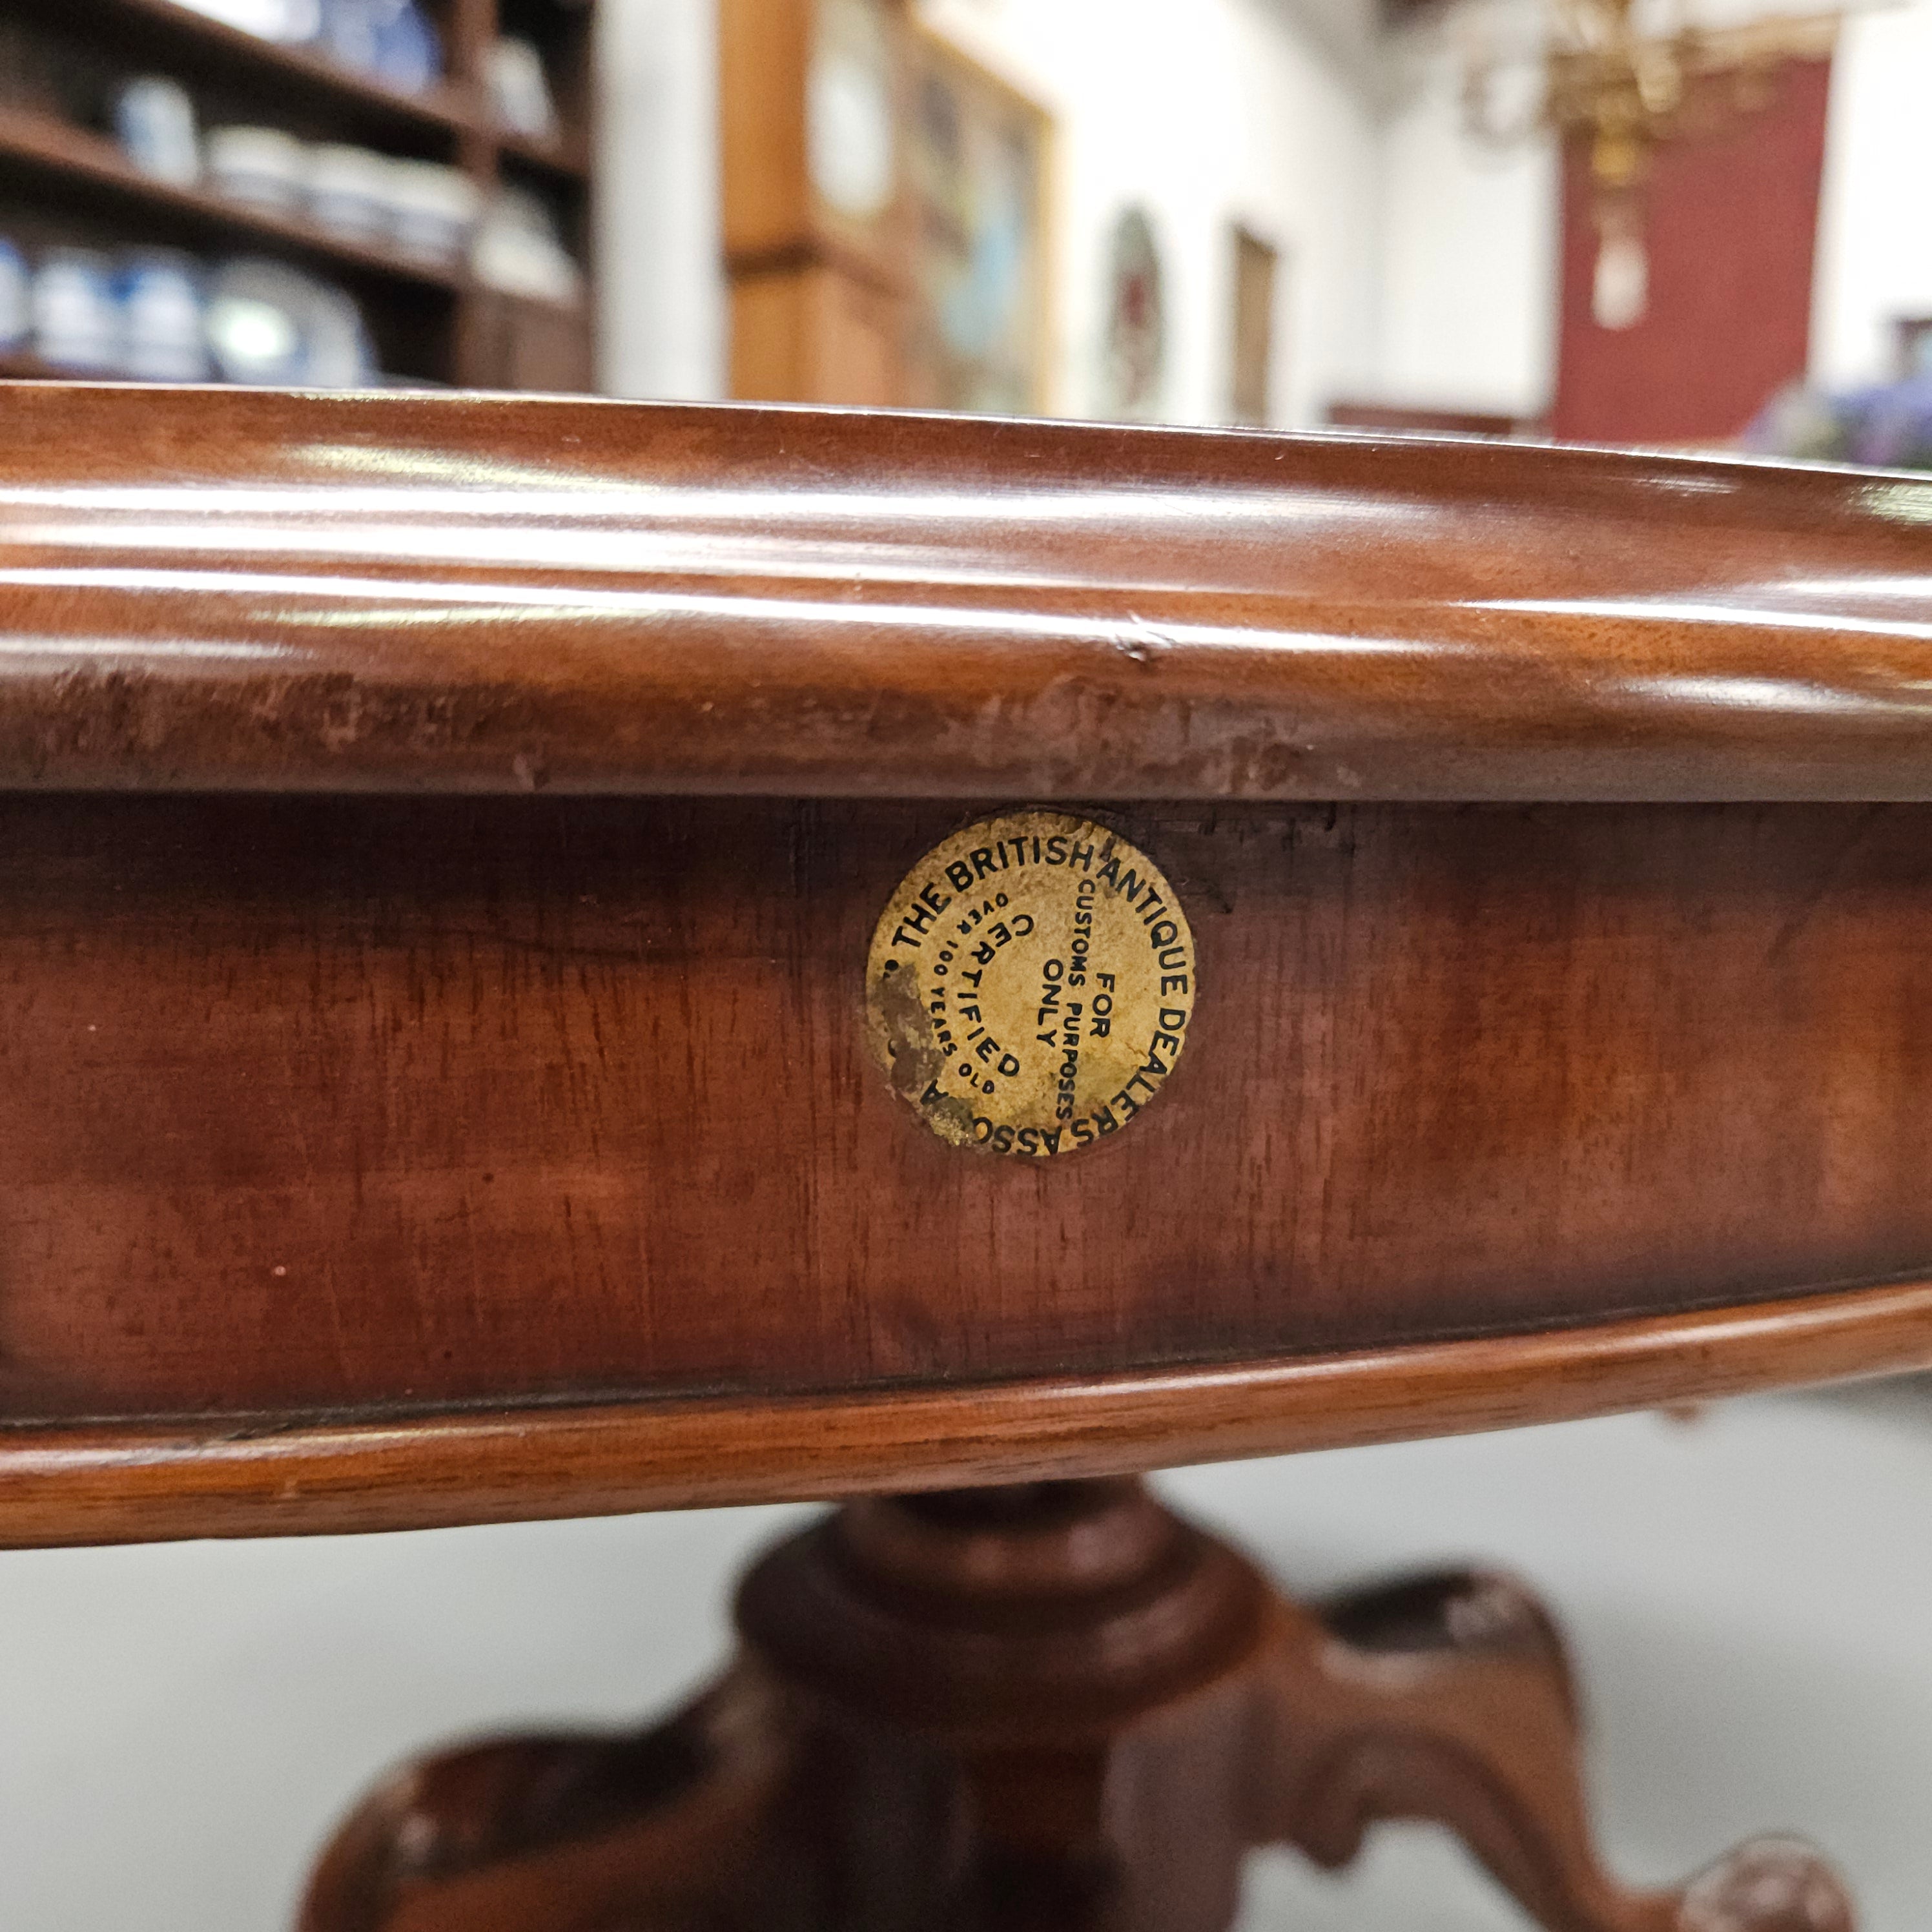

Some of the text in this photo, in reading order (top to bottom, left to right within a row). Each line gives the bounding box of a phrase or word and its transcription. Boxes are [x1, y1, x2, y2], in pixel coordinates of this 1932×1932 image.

[892, 882, 952, 947] THE
[945, 836, 1094, 892] BRITISH
[1096, 858, 1189, 996] ANTIQUE
[930, 892, 1009, 1094] OVER 100 YEARS OLD
[957, 914, 1034, 1077] CERTIFIED
[1036, 958, 1064, 1047] ONLY
[1055, 879, 1096, 1120] CUSTOMS PURPOSES
[1090, 972, 1116, 1038] FOR
[1071, 1008, 1187, 1147] DEALERS
